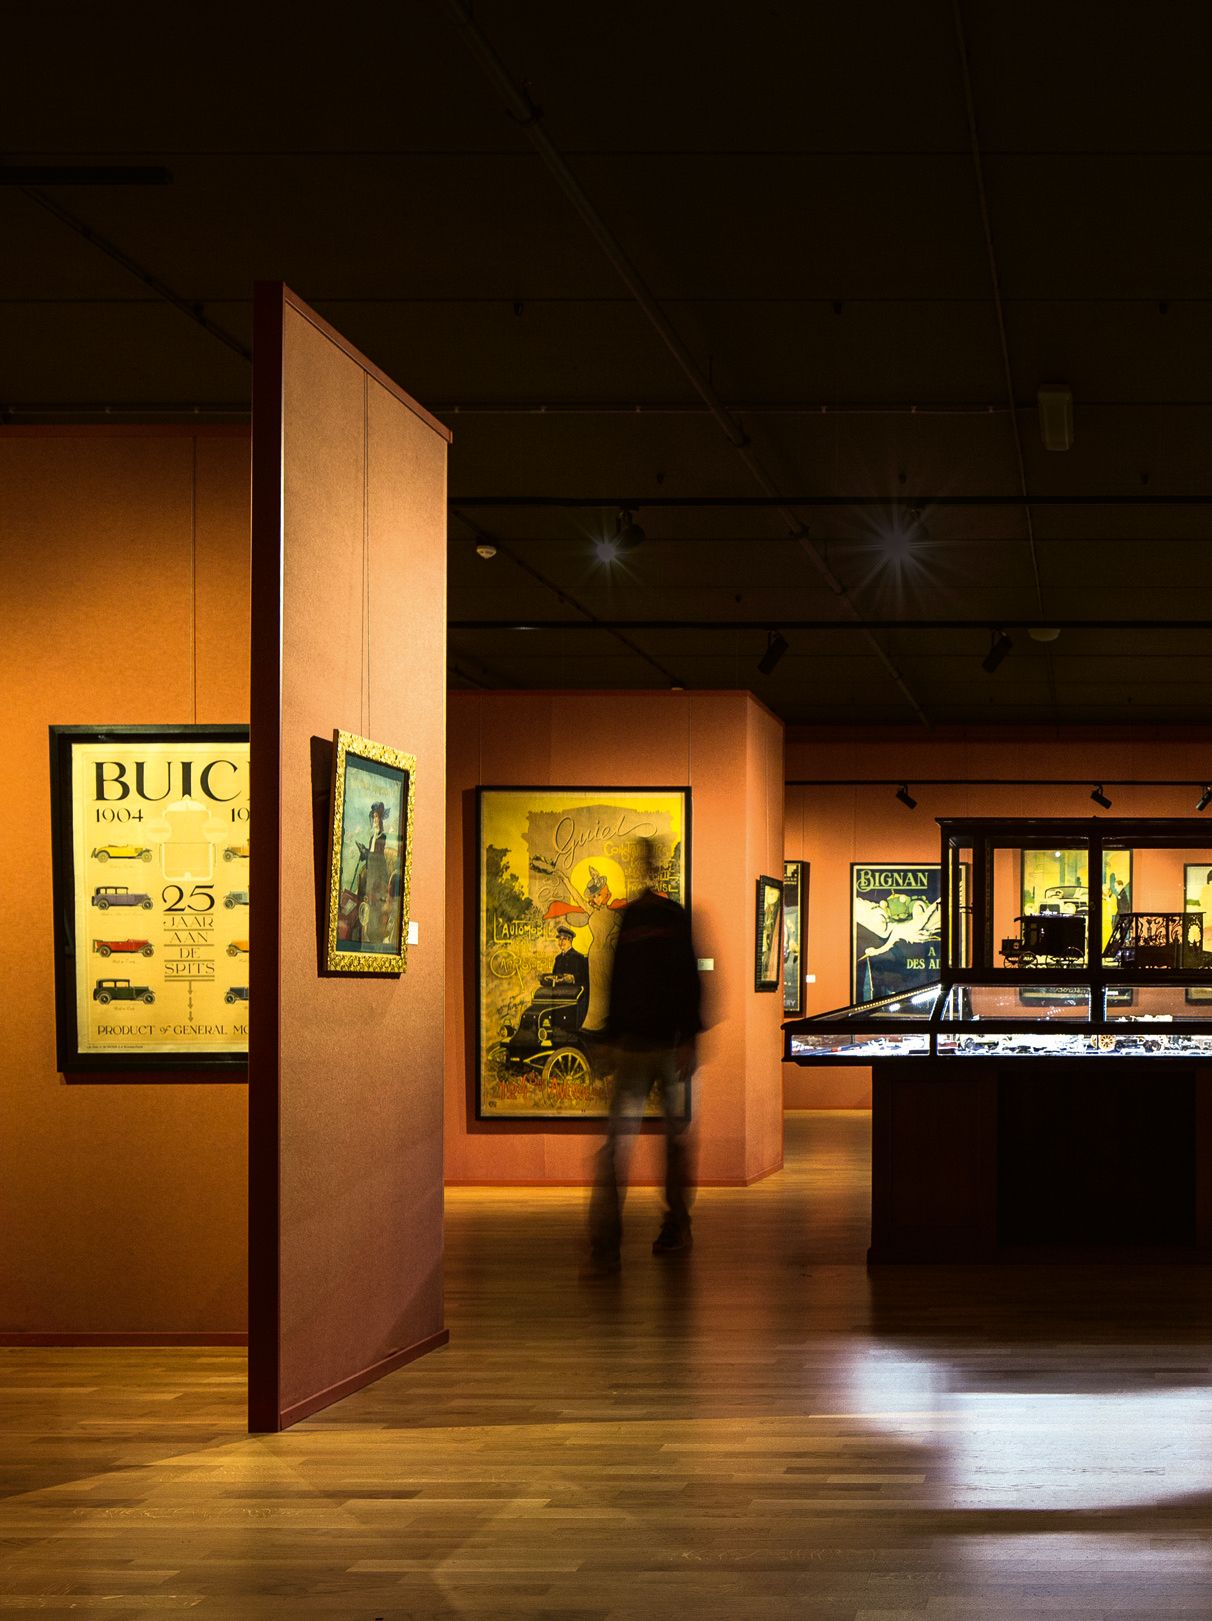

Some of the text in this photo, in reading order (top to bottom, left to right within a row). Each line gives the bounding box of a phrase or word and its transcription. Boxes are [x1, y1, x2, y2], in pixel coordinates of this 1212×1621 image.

[93, 760, 250, 802] BUIC
[96, 808, 144, 823] 1904
[857, 869, 928, 892] BIGNAN
[161, 884, 215, 912] 25
[163, 916, 214, 928] JAAR
[168, 932, 209, 943] AAN
[179, 948, 201, 959] DE
[927, 946, 937, 957] A
[164, 963, 216, 975] SPITS
[906, 958, 926, 970] DES
[97, 1024, 155, 1036] PRODUCT
[173, 1024, 228, 1036] GENERAL
